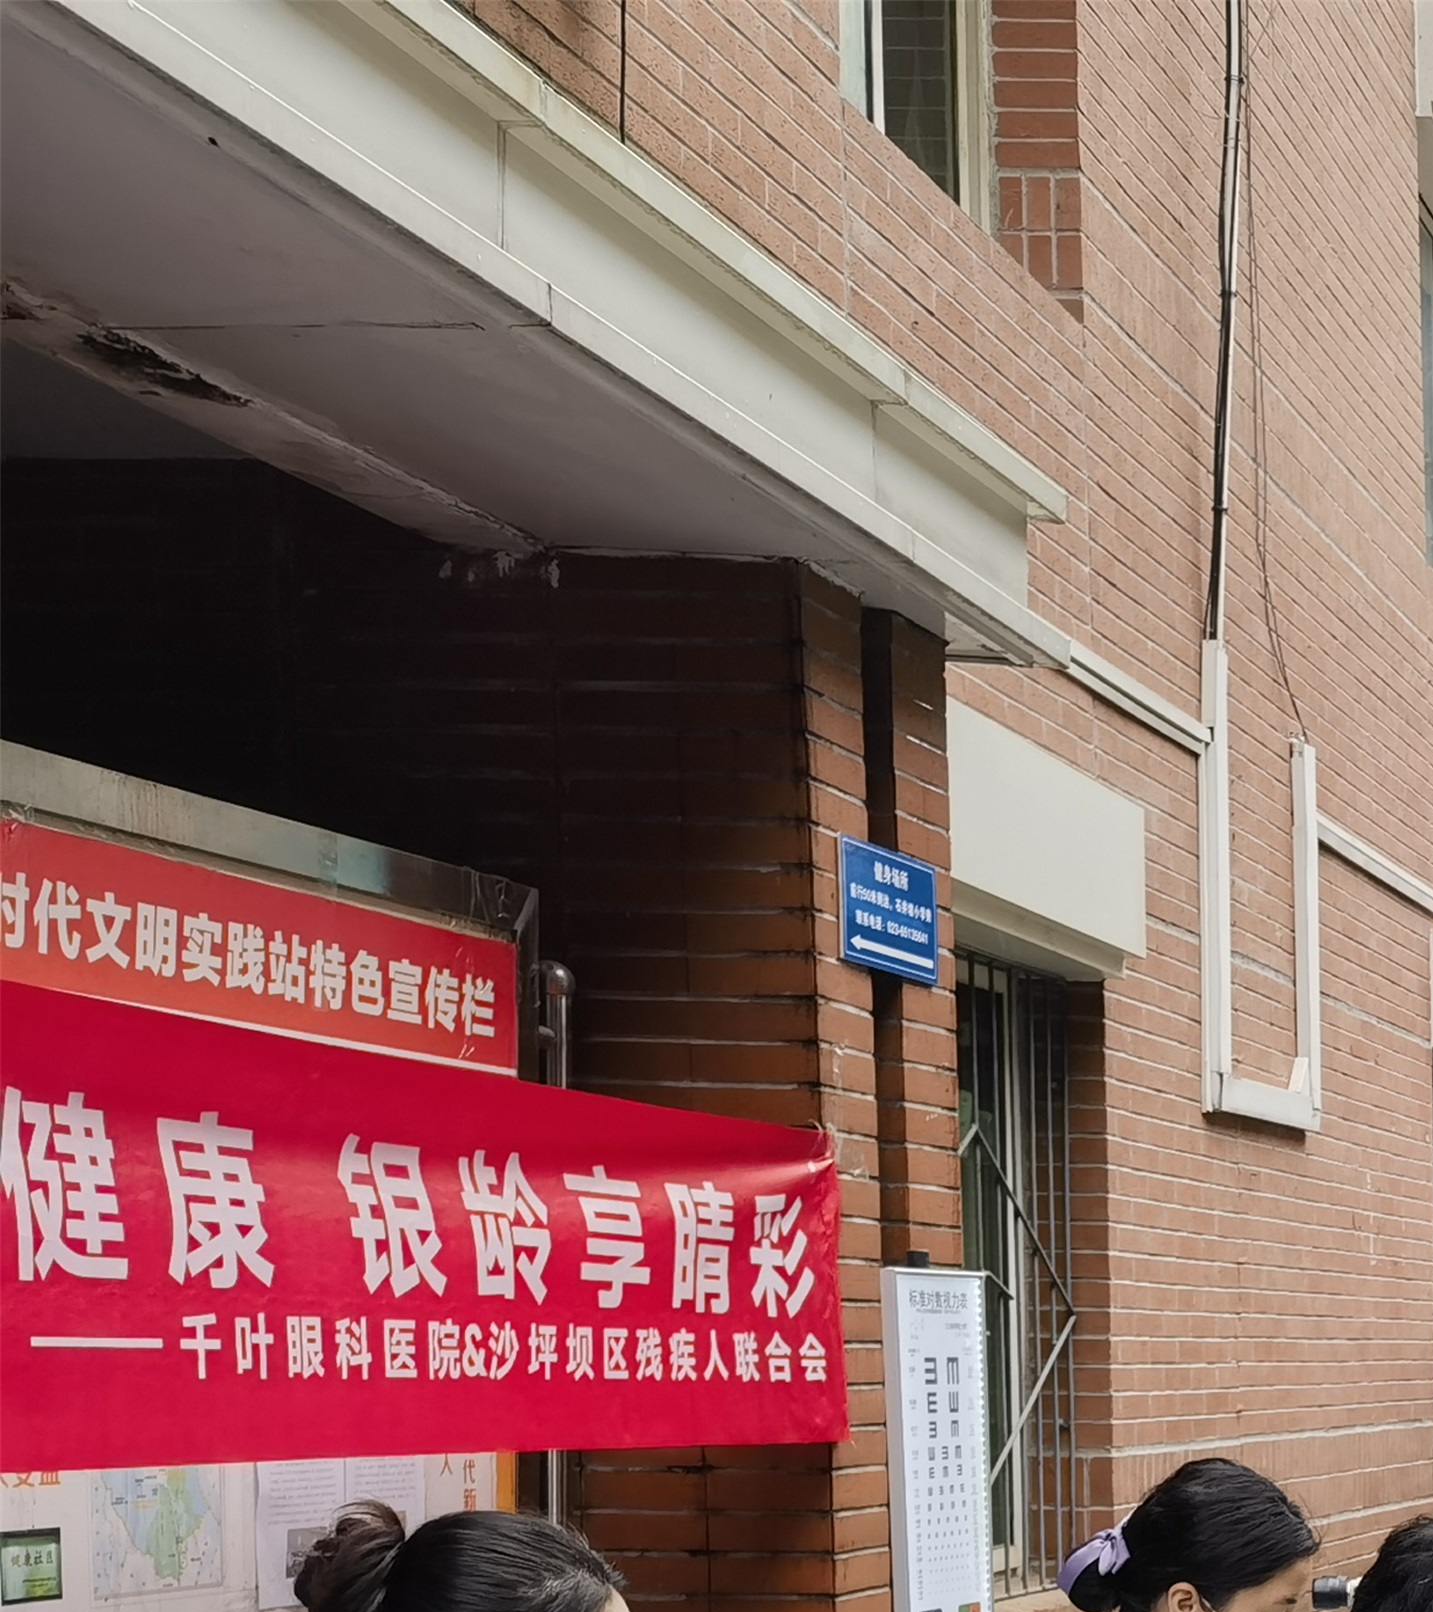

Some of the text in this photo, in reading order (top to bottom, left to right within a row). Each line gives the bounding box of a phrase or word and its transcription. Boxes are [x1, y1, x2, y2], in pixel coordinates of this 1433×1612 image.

[873, 860, 909, 891] 健身场所
[0, 872, 497, 1040] 时代文明实践站特色宣传栏
[0, 1085, 817, 1320] 健康 银龄享睛彩
[908, 1289, 968, 1309] 标准对数视力表
